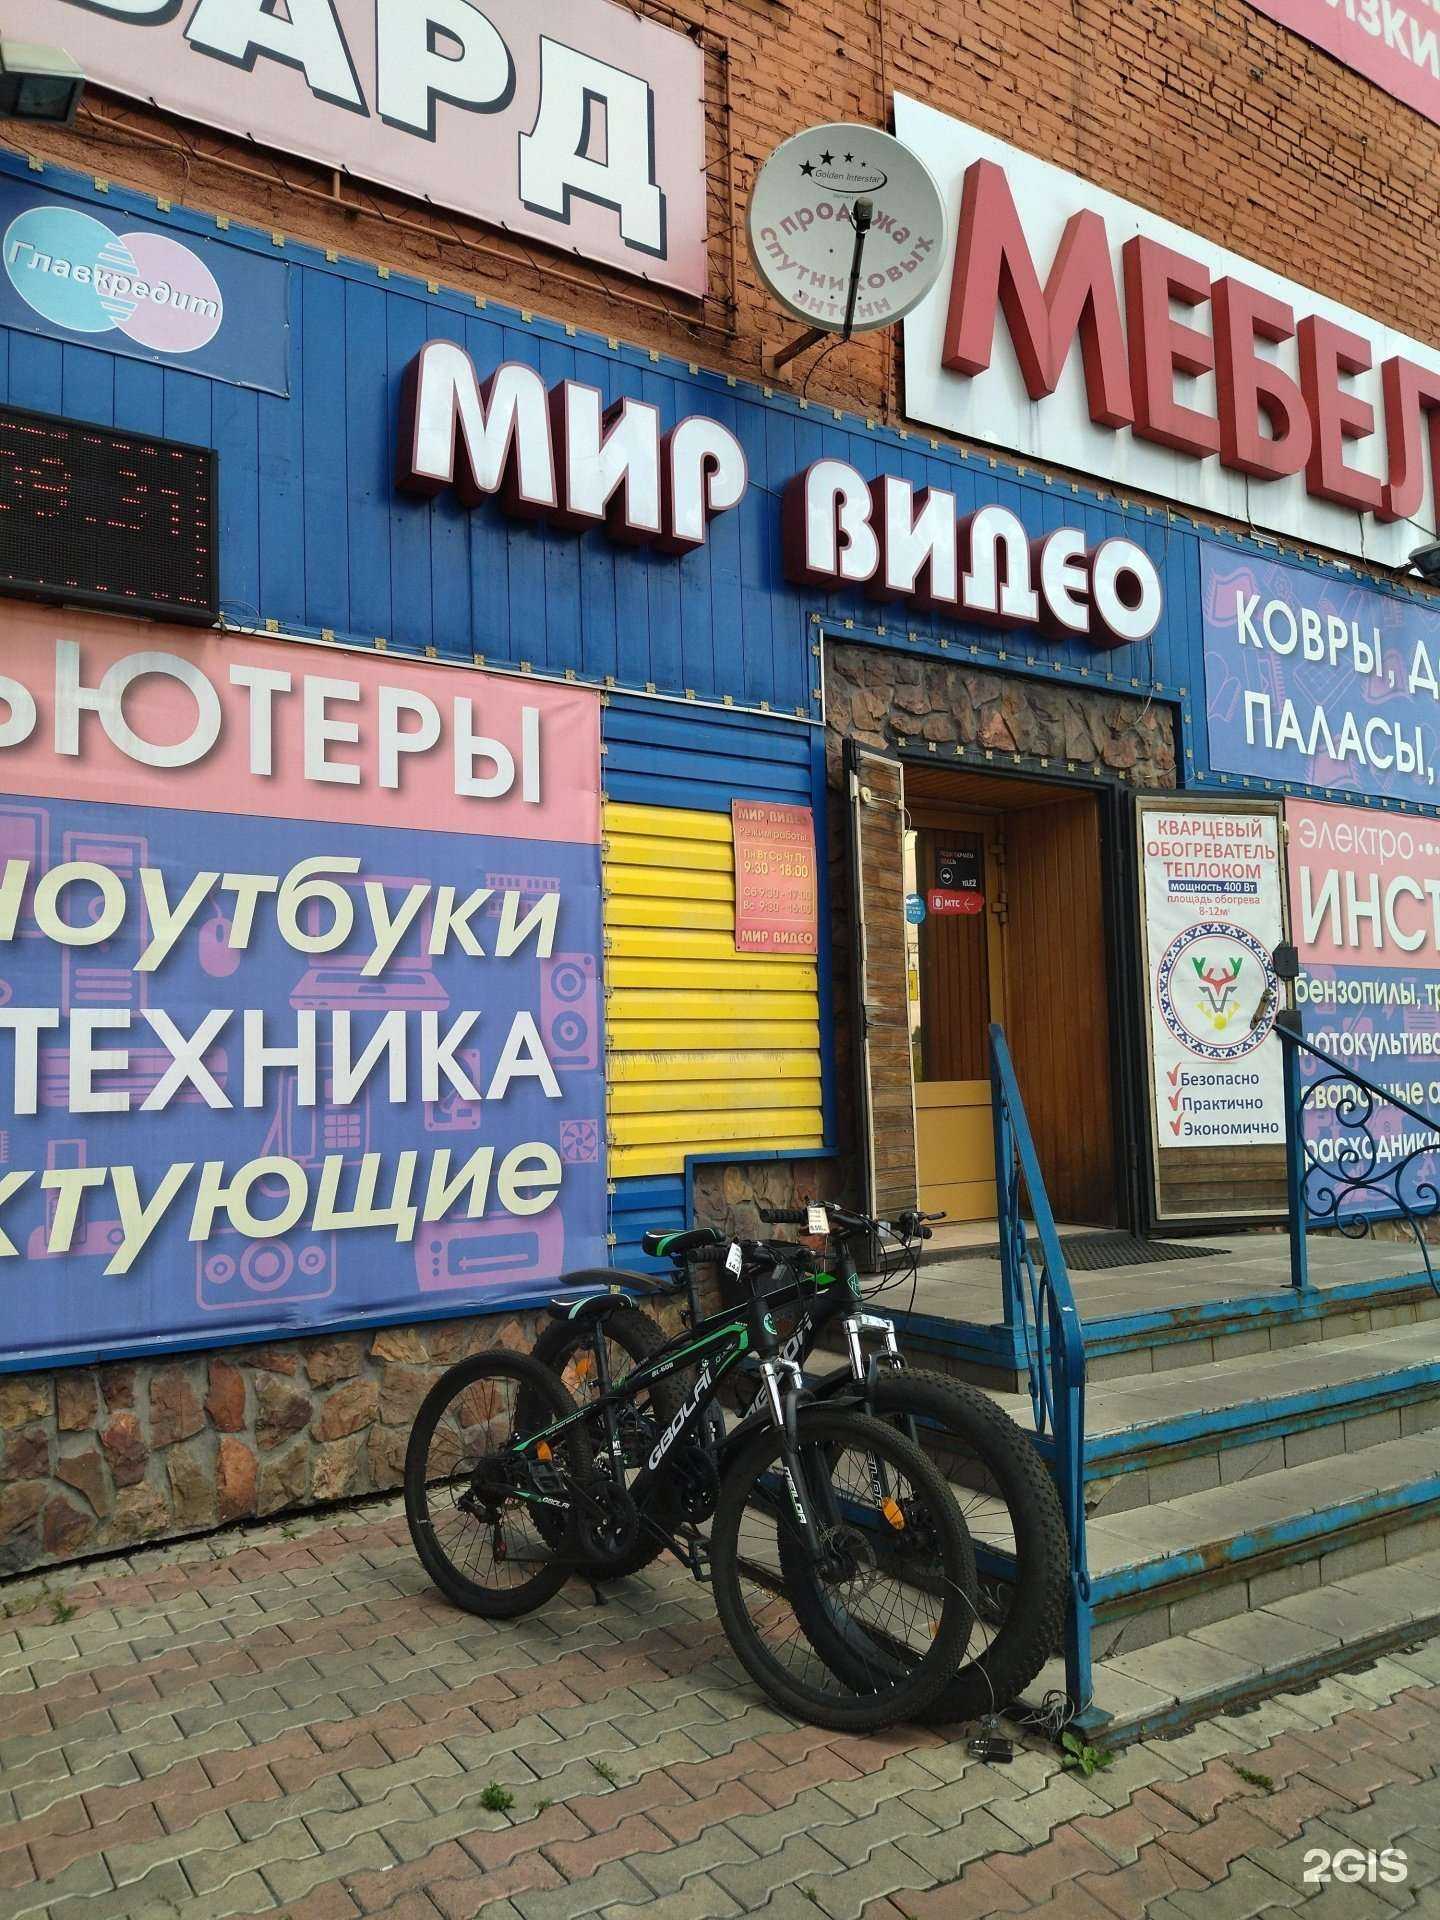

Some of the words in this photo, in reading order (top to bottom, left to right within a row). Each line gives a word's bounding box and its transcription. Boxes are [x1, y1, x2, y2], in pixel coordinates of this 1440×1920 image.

[815, 169, 844, 181] Golden
[846, 173, 880, 184] Interstar
[8, 240, 220, 320] Главкредит
[406, 339, 748, 548] МИР
[798, 458, 1163, 643] ВИДЕО
[1236, 590, 1395, 688] КОВРЫ,
[1244, 690, 1434, 785] ПАЛАСЫ,
[738, 807, 764, 821] МИР
[1157, 819, 1263, 840] КВАРЦЕВЫЙ
[1146, 841, 1276, 860] ОБОГРЕВАТЕЛЬ
[1163, 861, 1262, 879] ТЕПЛОКОМ
[1171, 883, 1222, 894] мощность
[1223, 882, 1241, 893] 400
[1243, 883, 1256, 893] Вт
[1167, 895, 1212, 905] площадь
[1215, 894, 1261, 906] обогрева
[741, 930, 768, 943] МИР
[773, 931, 812, 944] ВИДЕО
[1295, 972, 1420, 1010] бензопилы,
[1180, 1072, 1259, 1086] Безопасно
[1182, 1096, 1263, 1114] Практично
[1183, 1122, 1279, 1137] Экономично
